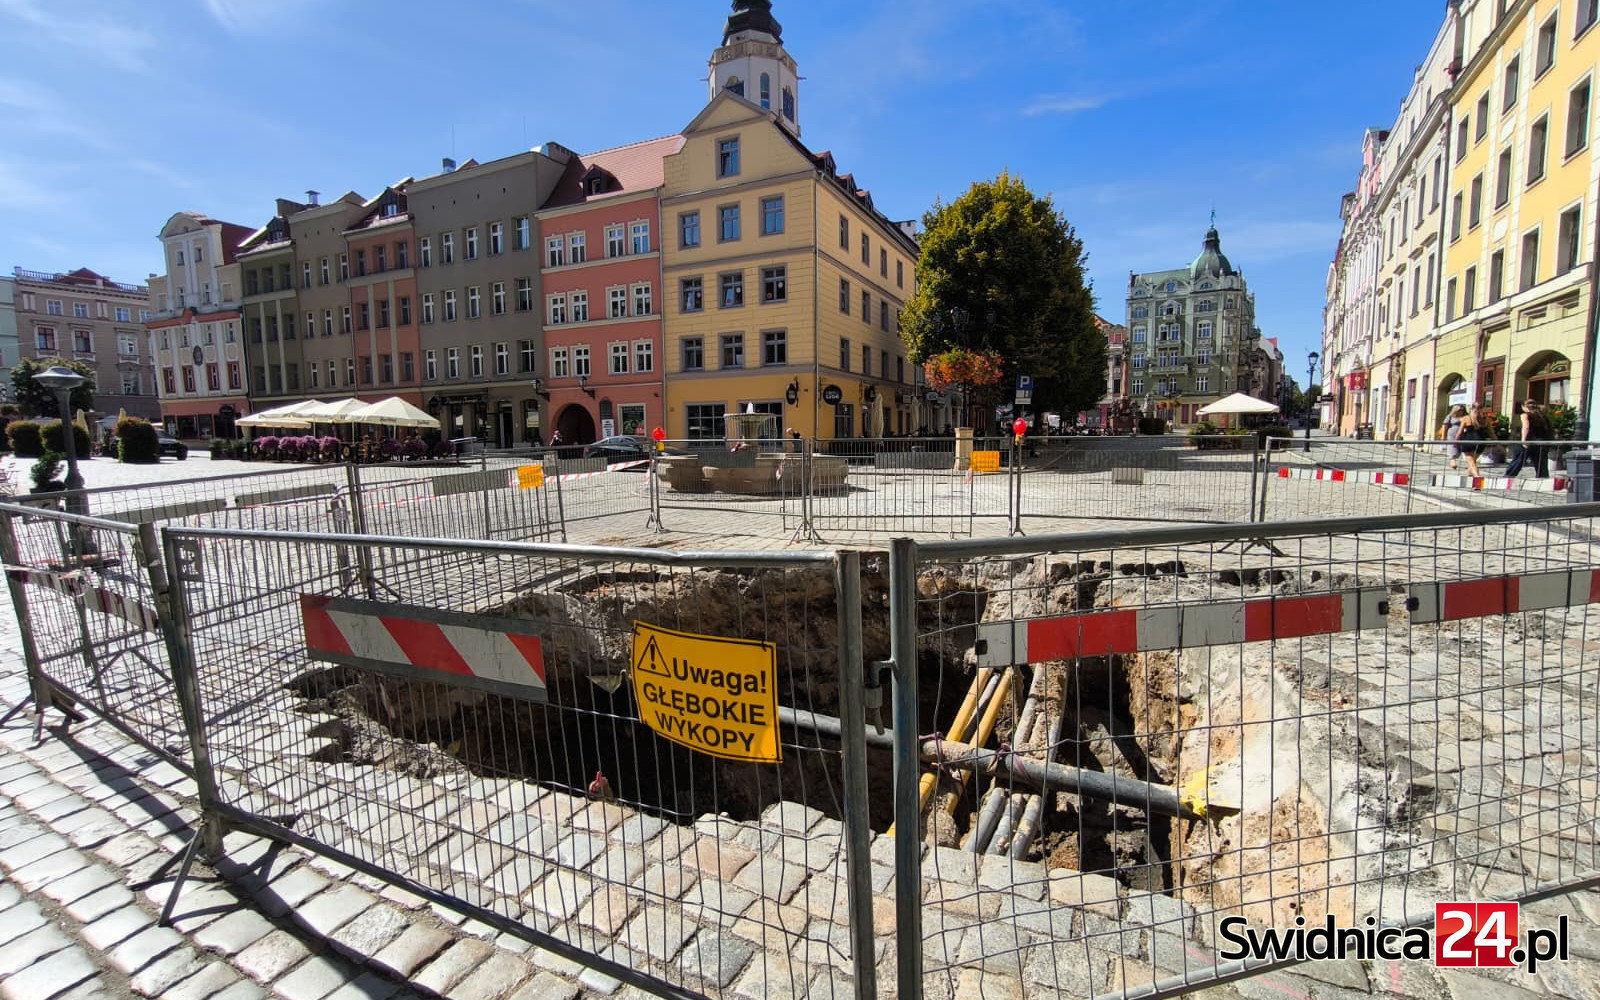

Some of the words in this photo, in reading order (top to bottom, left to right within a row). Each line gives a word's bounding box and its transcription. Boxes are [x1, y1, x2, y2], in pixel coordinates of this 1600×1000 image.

[1020, 375, 1030, 388] P
[673, 658, 766, 695] Uwaga!
[643, 683, 766, 725] GŁĘBOKIE
[655, 711, 755, 752] WYKOPY
